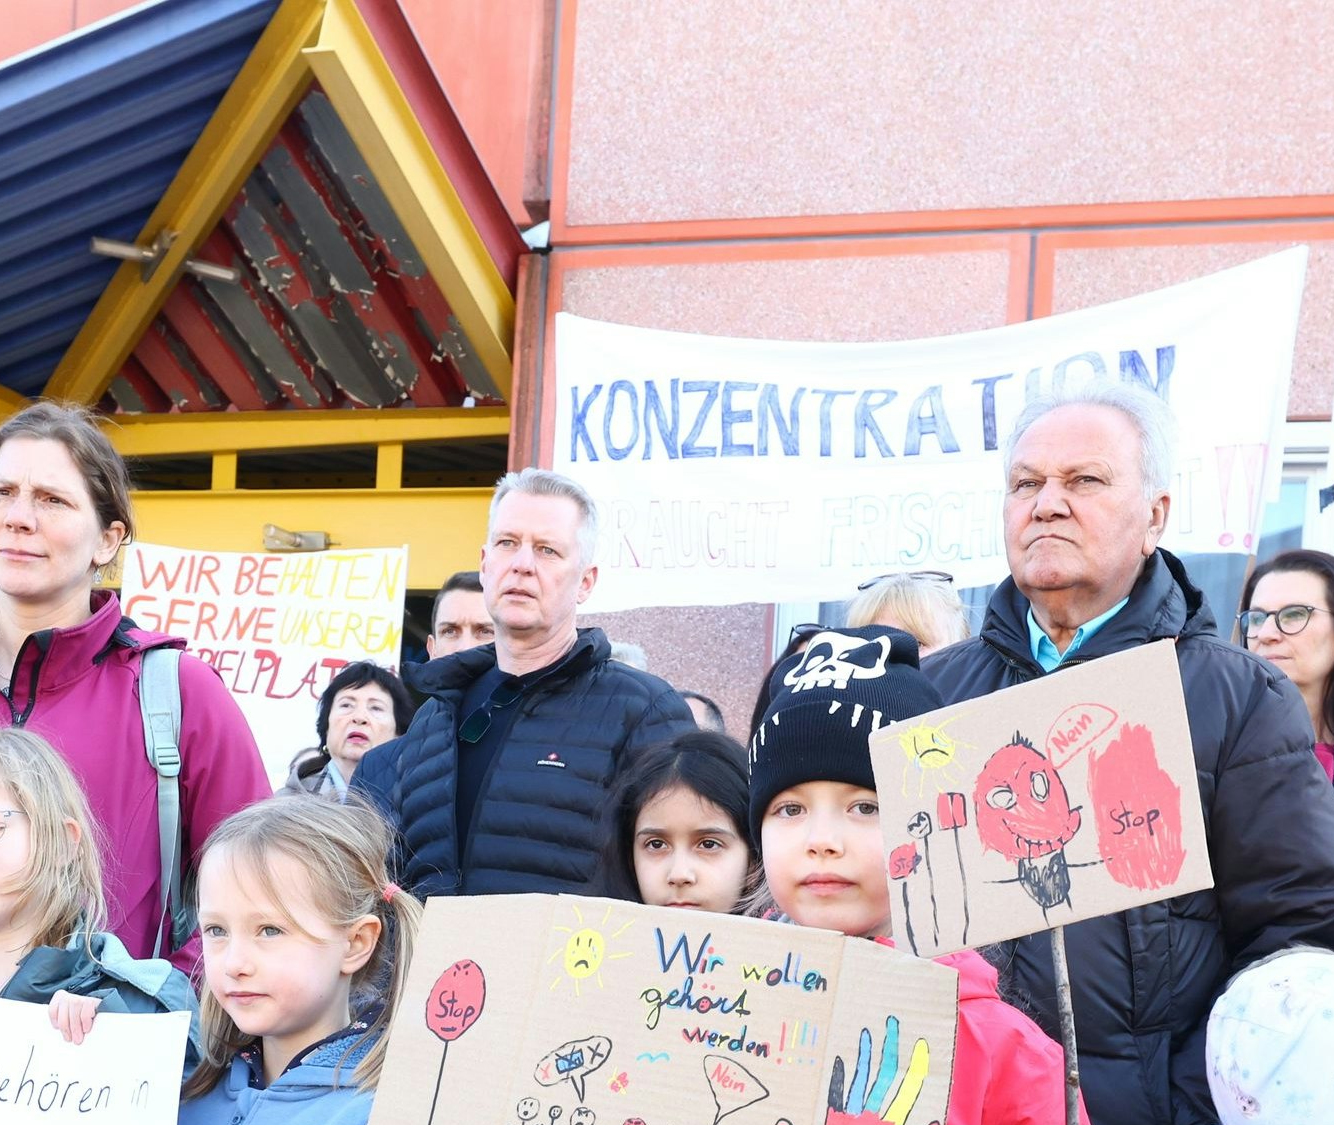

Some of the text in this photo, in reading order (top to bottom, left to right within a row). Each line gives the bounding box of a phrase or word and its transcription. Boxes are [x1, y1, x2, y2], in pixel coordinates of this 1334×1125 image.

[819, 488, 1004, 566] FRISCH
[136, 549, 403, 603] WIR BEHALTEN
[279, 607, 403, 655] UNSEREN
[1051, 713, 1093, 754] Nein
[1110, 799, 1160, 837] Stop
[653, 926, 828, 992] Wir wollen
[434, 995, 475, 1022] Stop
[639, 975, 751, 1030] gehört
[710, 1062, 747, 1094] Nein
